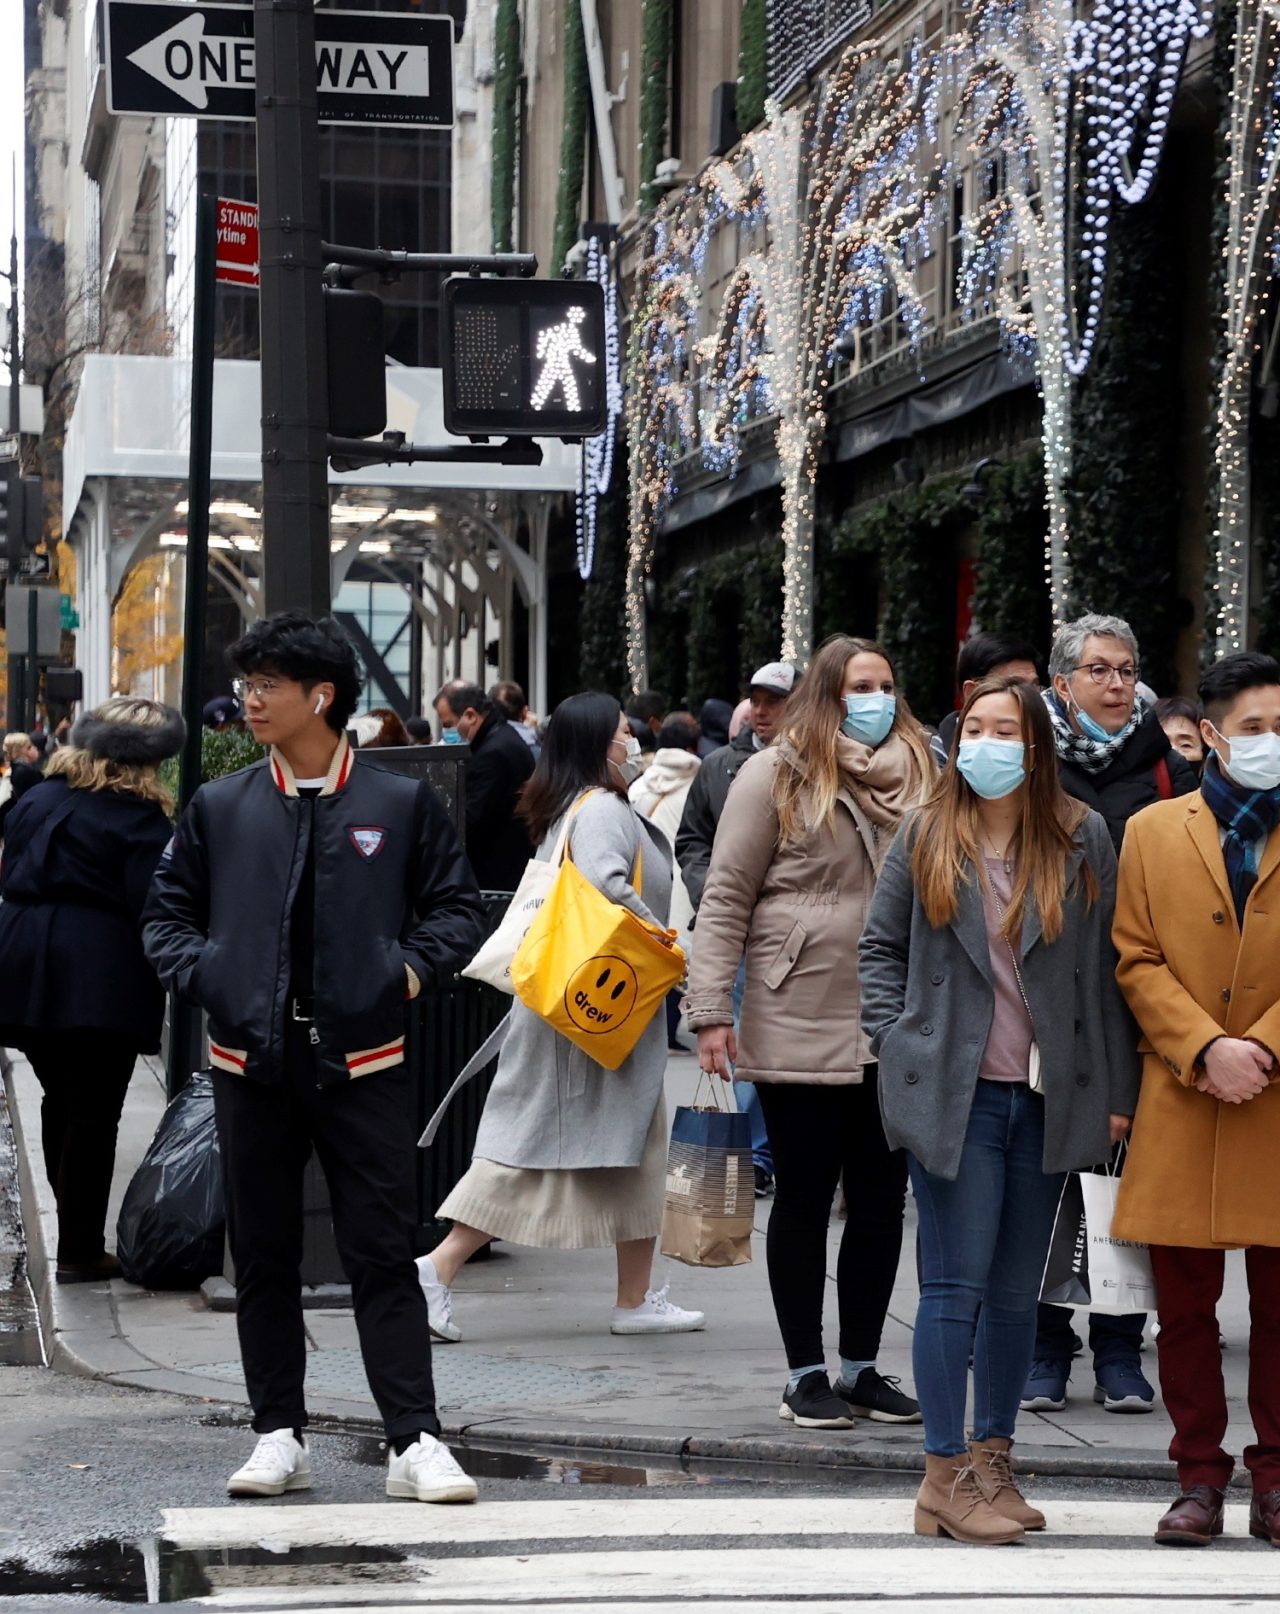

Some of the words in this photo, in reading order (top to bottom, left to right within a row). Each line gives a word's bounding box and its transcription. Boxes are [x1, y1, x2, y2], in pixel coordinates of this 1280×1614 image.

[165, 39, 255, 83] ONE
[317, 47, 409, 90] WAY
[365, 113, 440, 121] TRANSPORTATION
[574, 990, 614, 1024] drew
[724, 1155, 739, 1215] HOLLISTER
[1093, 1236, 1133, 1249] AMERICAN
